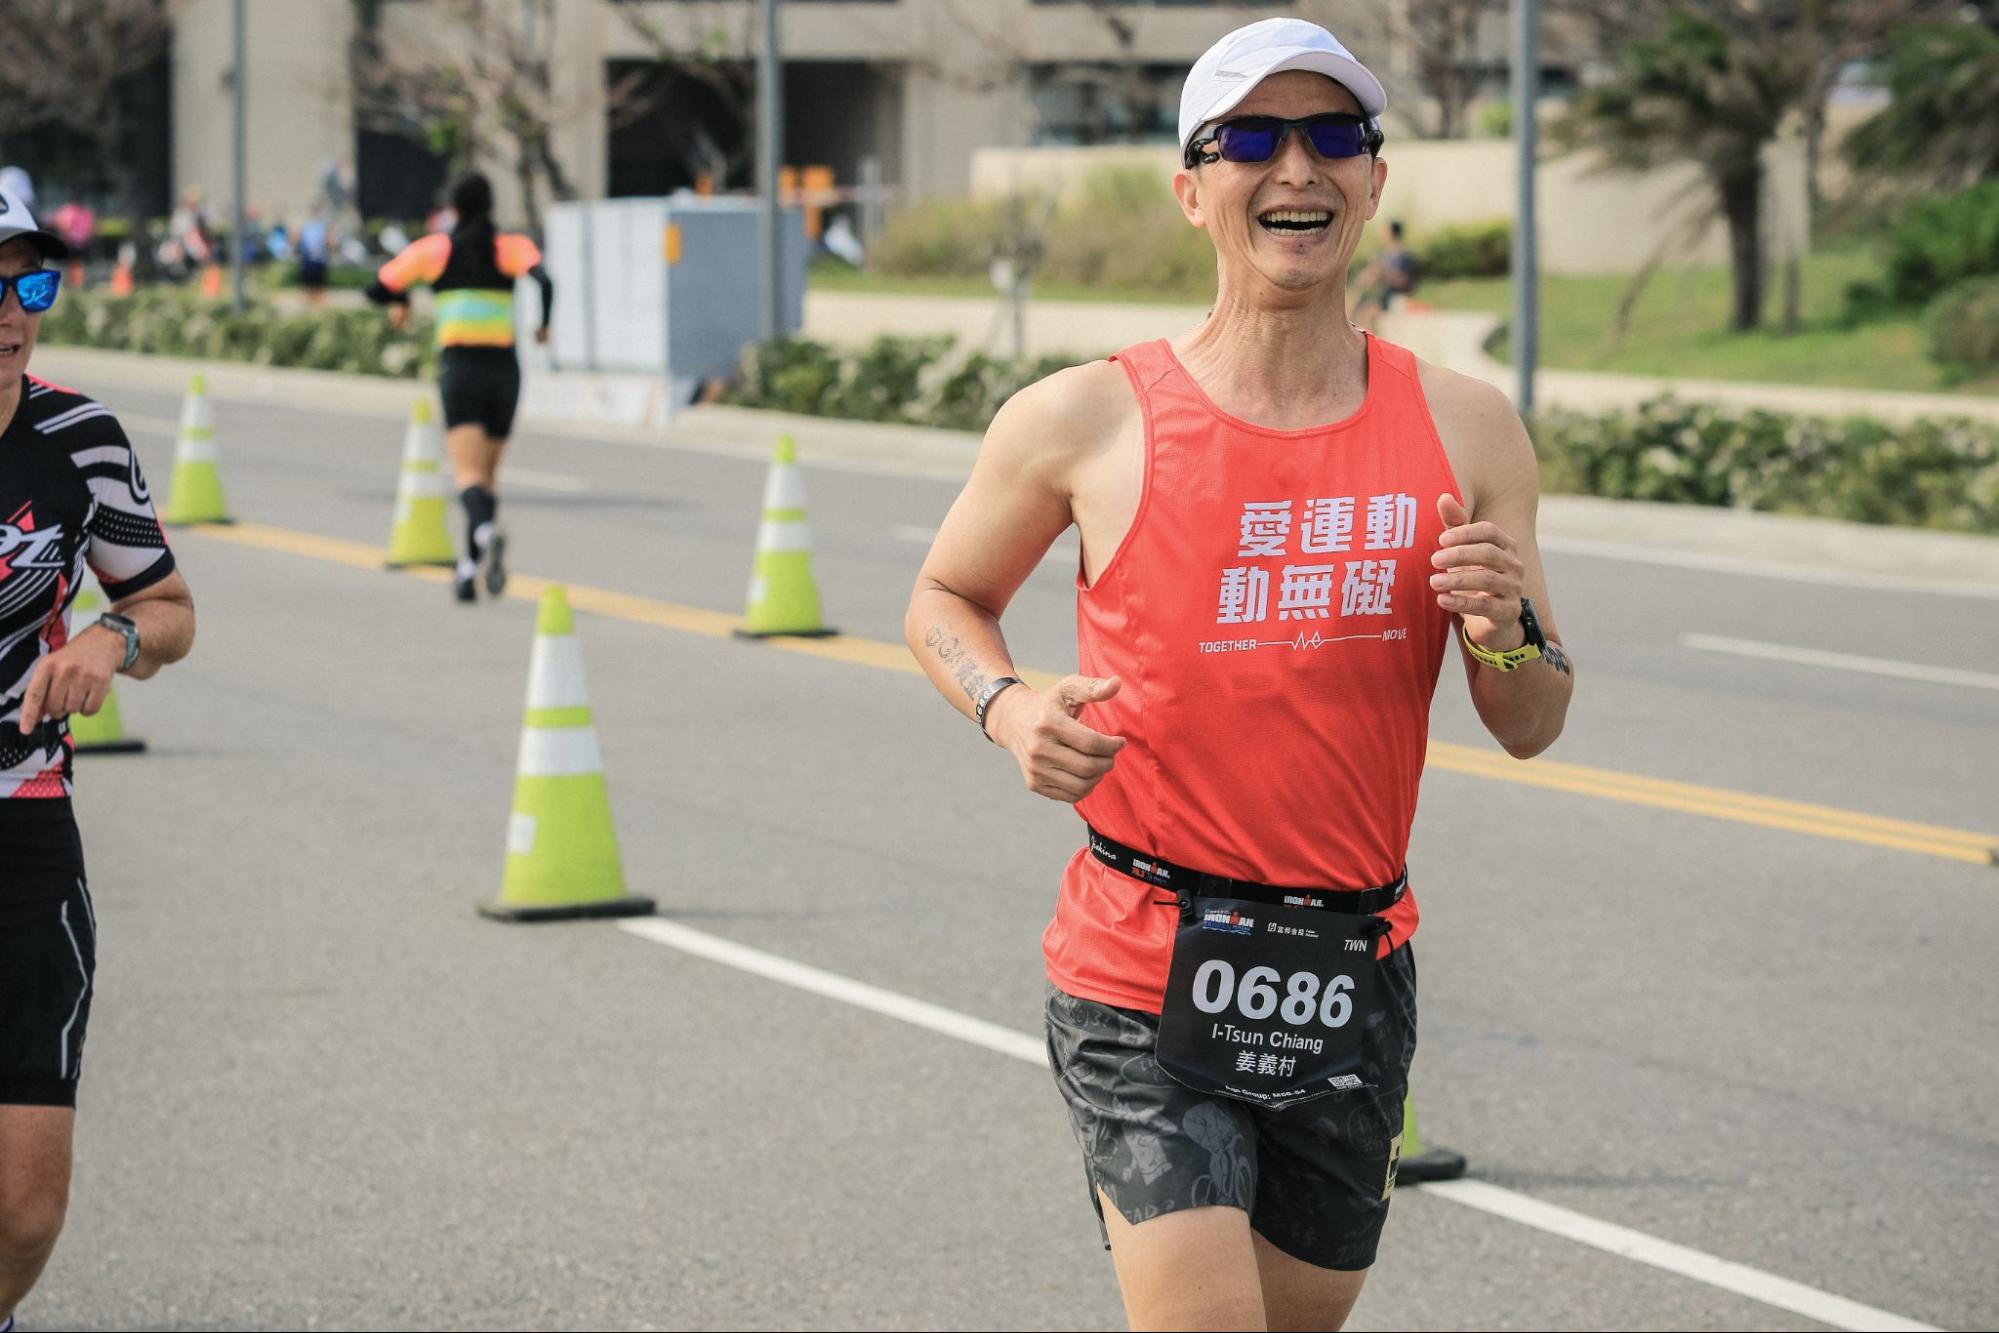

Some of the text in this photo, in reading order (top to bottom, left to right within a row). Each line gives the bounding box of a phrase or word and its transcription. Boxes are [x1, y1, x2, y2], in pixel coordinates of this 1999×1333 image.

[1238, 493, 1417, 557] 愛運動
[1216, 559, 1397, 624] 動無礙
[1199, 628, 1407, 653] TOGETHER MOVE
[1344, 939, 1368, 952] TWN
[1192, 959, 1356, 1028] 0686
[1211, 1023, 1324, 1055] I-Tsun Chiang
[1235, 1051, 1297, 1078] 姜義村
